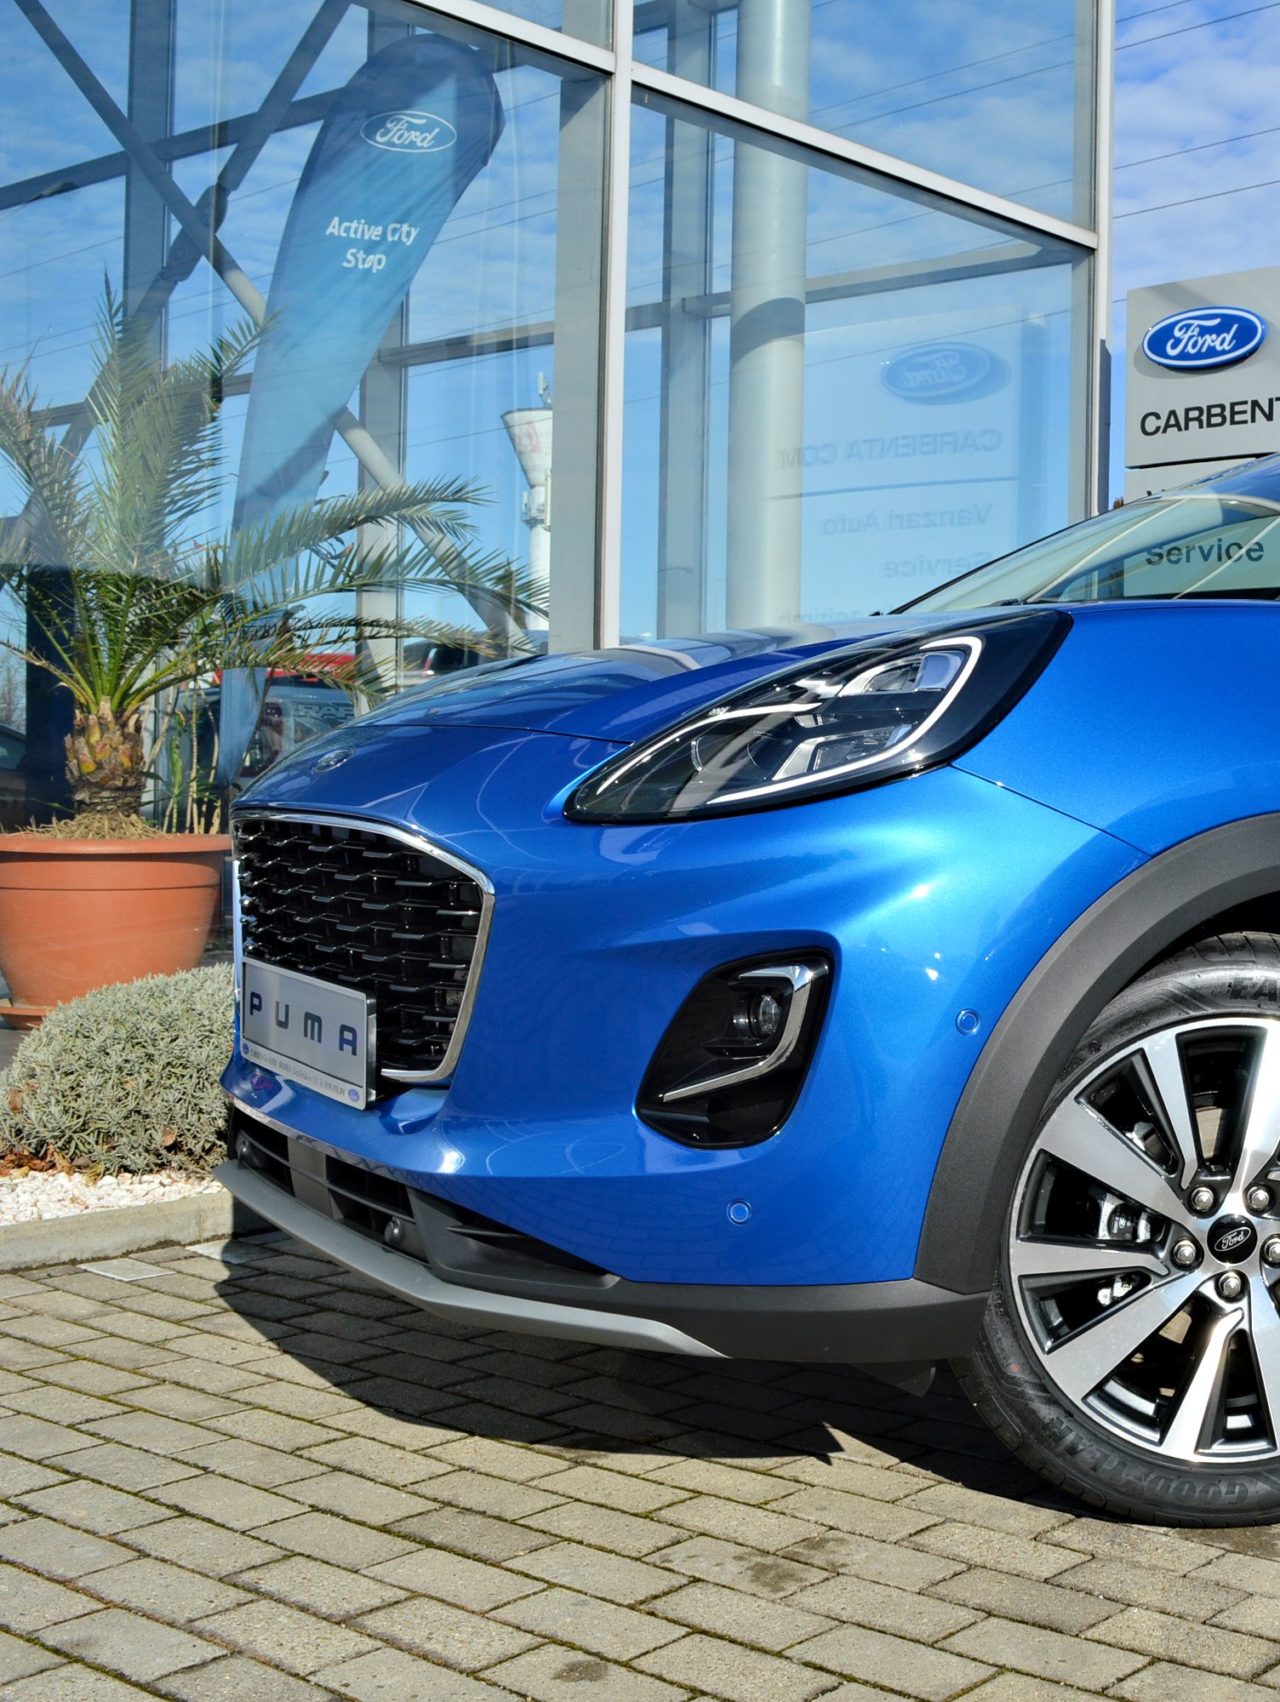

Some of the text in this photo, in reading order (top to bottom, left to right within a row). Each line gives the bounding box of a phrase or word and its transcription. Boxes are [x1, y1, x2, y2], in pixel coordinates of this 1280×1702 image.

[375, 115, 440, 148] Ford
[325, 216, 420, 246] Active City
[342, 248, 387, 273] Stop
[1165, 317, 1239, 357] Ford
[1145, 537, 1265, 567] Service
[249, 991, 359, 1057] PUMA
